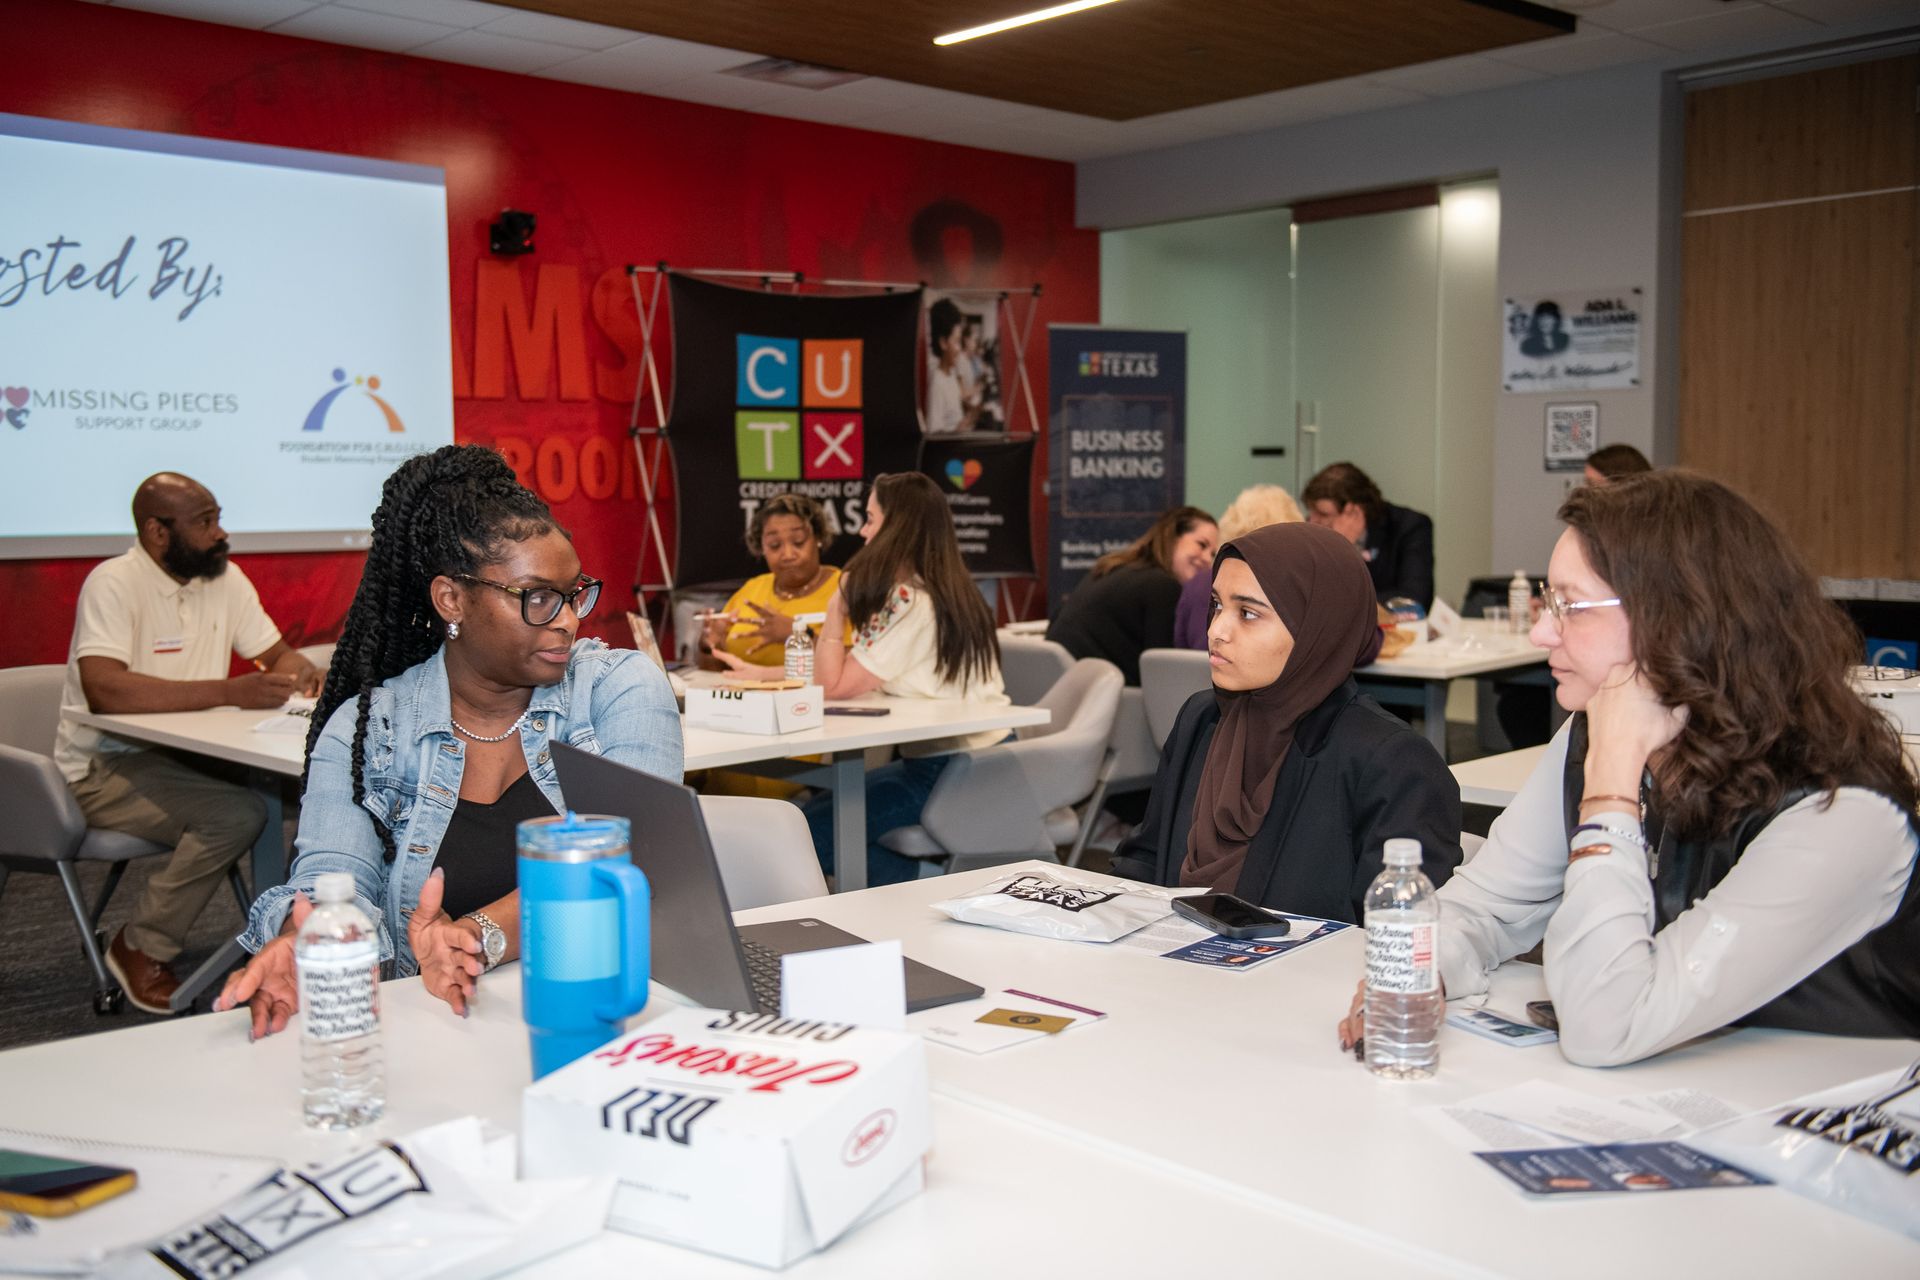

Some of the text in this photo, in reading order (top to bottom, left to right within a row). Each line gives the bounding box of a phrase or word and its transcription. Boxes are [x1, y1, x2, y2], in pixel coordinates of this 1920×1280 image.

[149, 236, 223, 322] By:
[454, 259, 660, 404] MS
[1100, 357, 1158, 378] TEXAS
[33, 388, 239, 414] MISSING PIECES
[75, 415, 202, 431] SUPPORT GROUP
[1071, 430, 1164, 452] BUSINESS
[1070, 456, 1164, 478] BANKING
[739, 481, 864, 498] CREDIT UNION OF
[739, 499, 864, 535] TAS
[595, 1033, 860, 1093] Jason's
[600, 1086, 722, 1146] DELI
